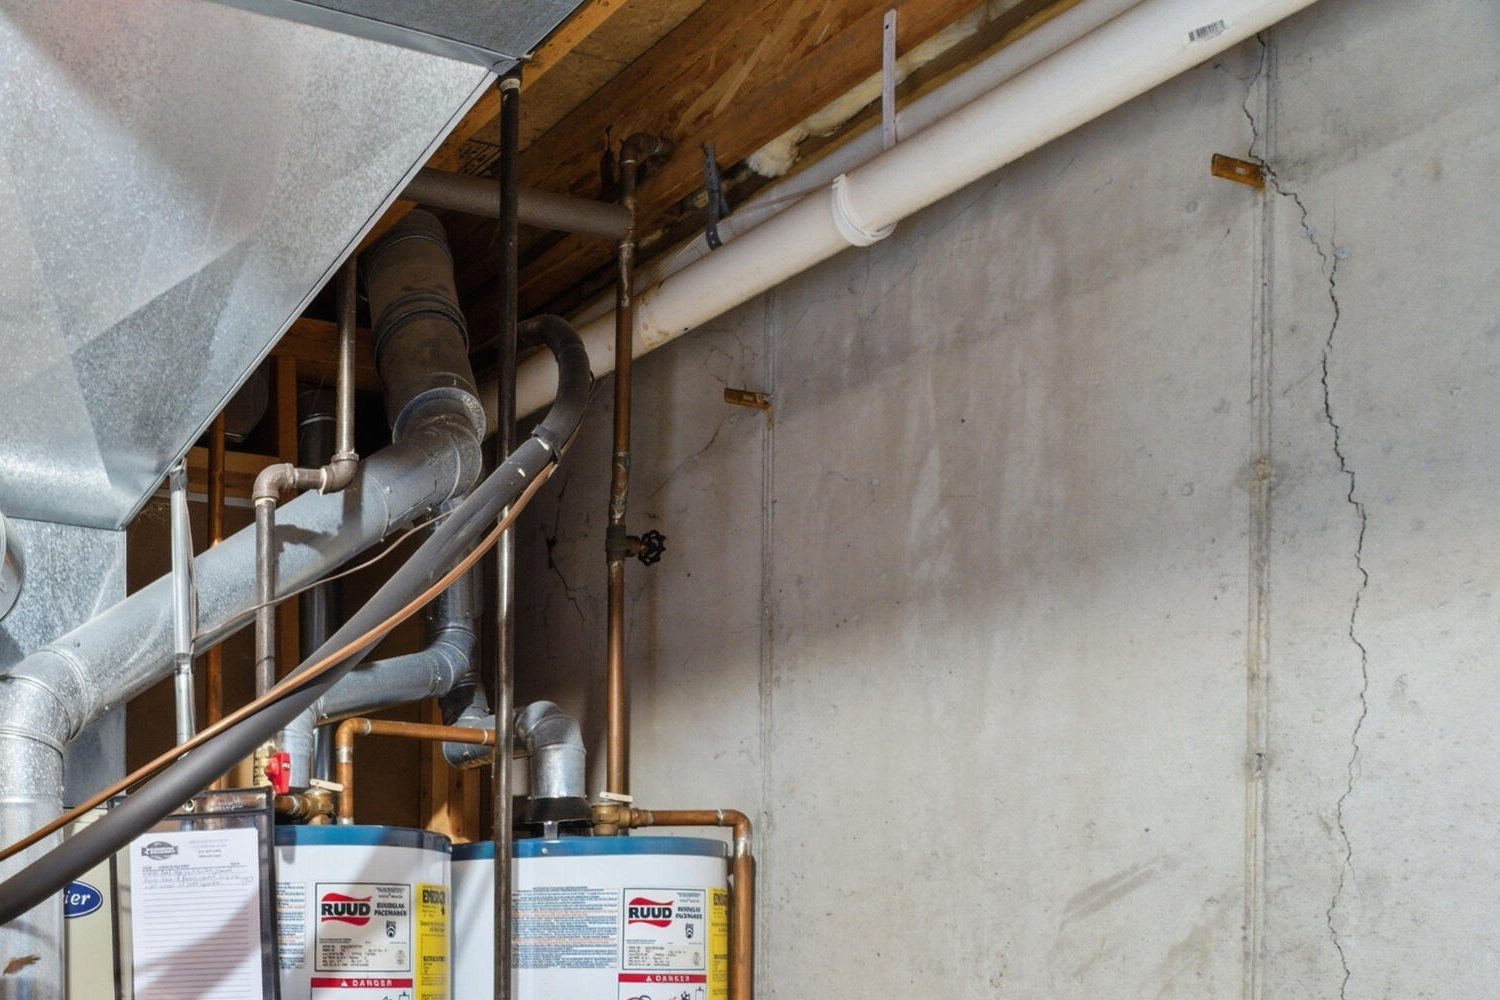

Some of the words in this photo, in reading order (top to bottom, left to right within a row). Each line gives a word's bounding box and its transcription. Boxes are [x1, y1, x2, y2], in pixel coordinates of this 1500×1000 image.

[321, 902, 371, 916] RUUD
[628, 907, 673, 919] RUUD
[352, 979, 393, 987] DANGER
